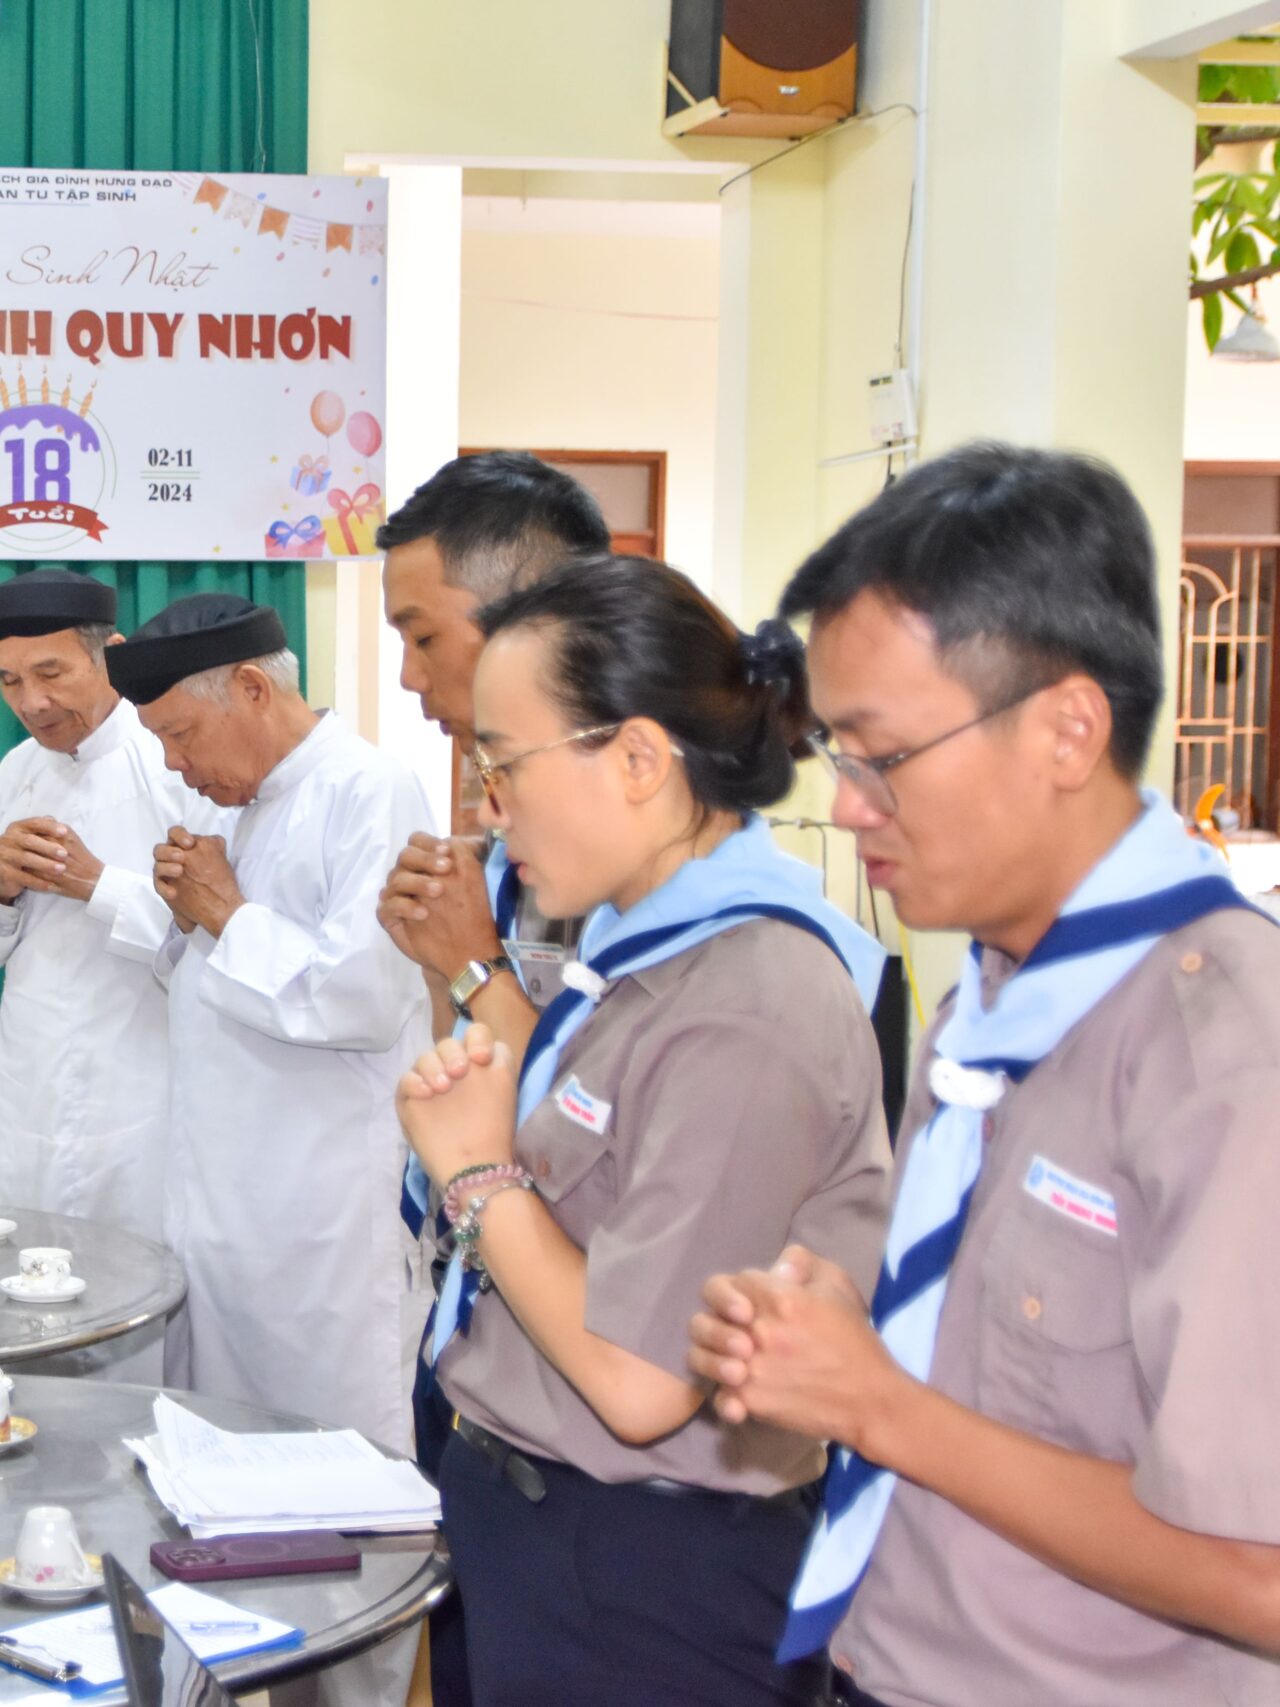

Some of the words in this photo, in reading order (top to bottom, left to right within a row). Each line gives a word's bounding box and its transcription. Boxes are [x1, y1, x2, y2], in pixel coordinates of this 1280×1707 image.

[26, 176, 50, 184] GIA
[25, 190, 49, 199] TU
[55, 188, 90, 204] TẬP
[96, 192, 137, 202] SINH
[5, 245, 109, 285] Sinh
[112, 246, 220, 293] Nhật
[66, 308, 184, 366] QUY
[198, 306, 352, 362] NHƠN
[148, 448, 194, 467] 02-11
[4, 438, 71, 503] 18
[148, 484, 194, 502] 2024
[7, 505, 75, 522] Tuổi
